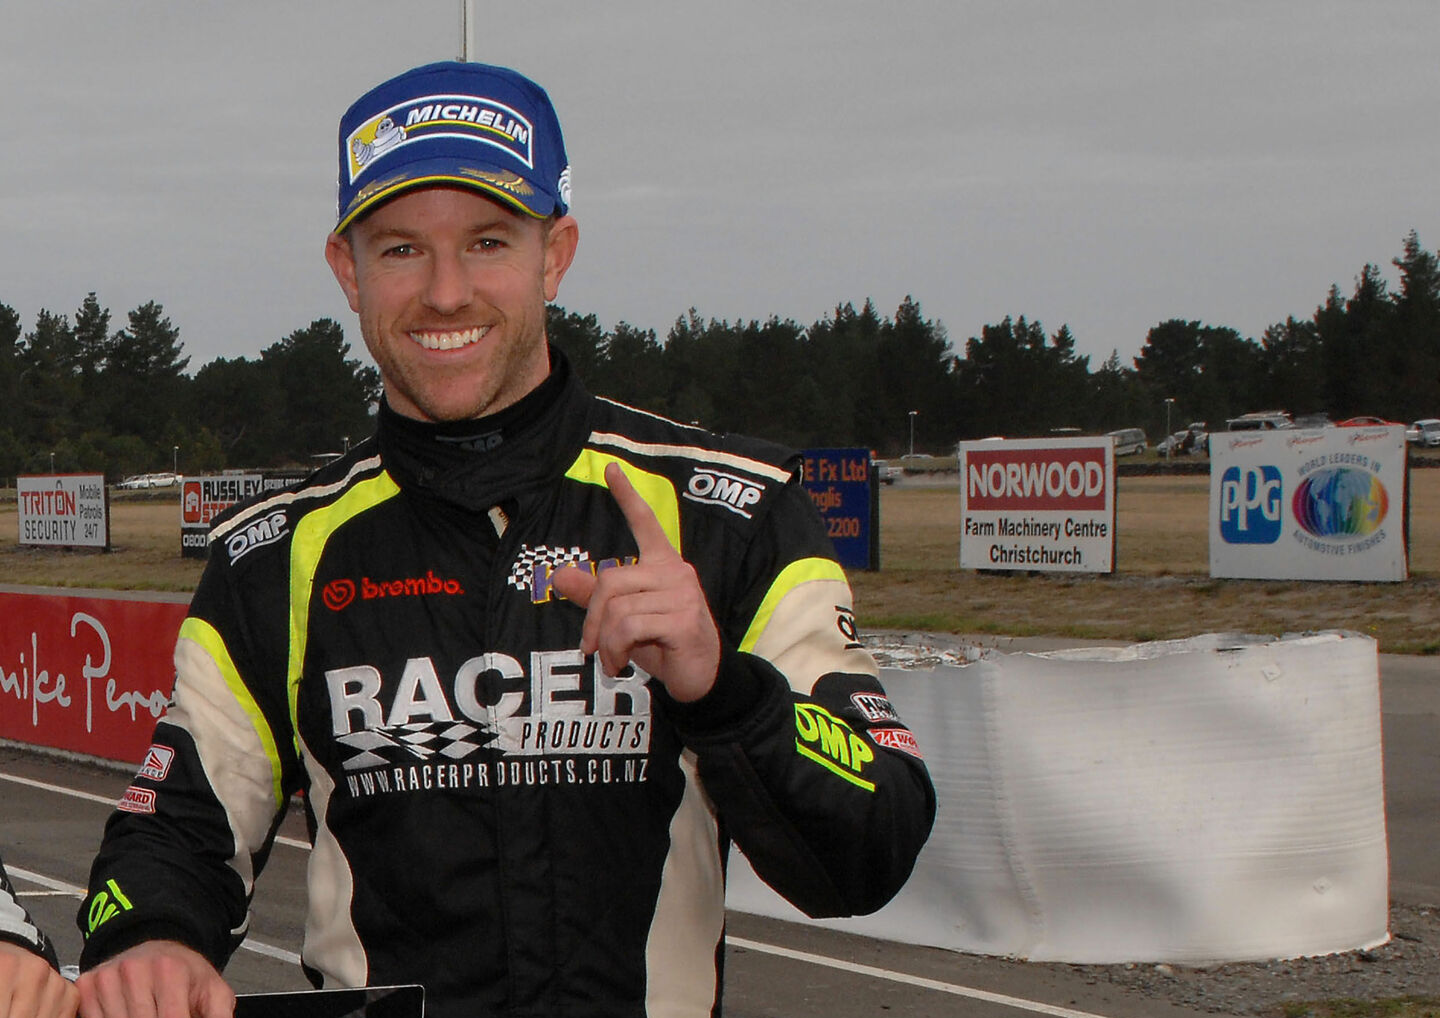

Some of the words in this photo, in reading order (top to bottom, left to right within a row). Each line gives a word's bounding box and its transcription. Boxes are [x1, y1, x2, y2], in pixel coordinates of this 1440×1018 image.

[406, 104, 529, 144] MICHELIN
[842, 458, 867, 481] Ltd
[969, 461, 1104, 498] NORWOOD
[1297, 455, 1328, 477] WORLD
[1329, 452, 1368, 468] LEADERS
[1370, 460, 1382, 473] IN
[20, 490, 76, 516] TRITON
[79, 484, 101, 500] Mobile
[688, 473, 761, 508] OMP
[1221, 466, 1281, 531] PPG
[24, 520, 77, 541] SECURITY
[79, 504, 102, 520] Patrols
[84, 523, 98, 538] 24/7
[228, 513, 288, 558] OMP
[965, 518, 994, 536] Farm
[998, 518, 1061, 541] Machinery
[1065, 518, 1107, 537] Centre
[183, 534, 205, 547] 0800
[990, 544, 1082, 564] Christchurch
[1293, 530, 1345, 556] AUTOMOTIVE
[1348, 529, 1387, 554] FINISHES
[325, 649, 652, 737] RACER
[521, 720, 646, 749] PRODUCTS
[795, 704, 874, 772] OMP
[346, 758, 649, 799] WWW.RACERPRODUCTS.CO.NZ
